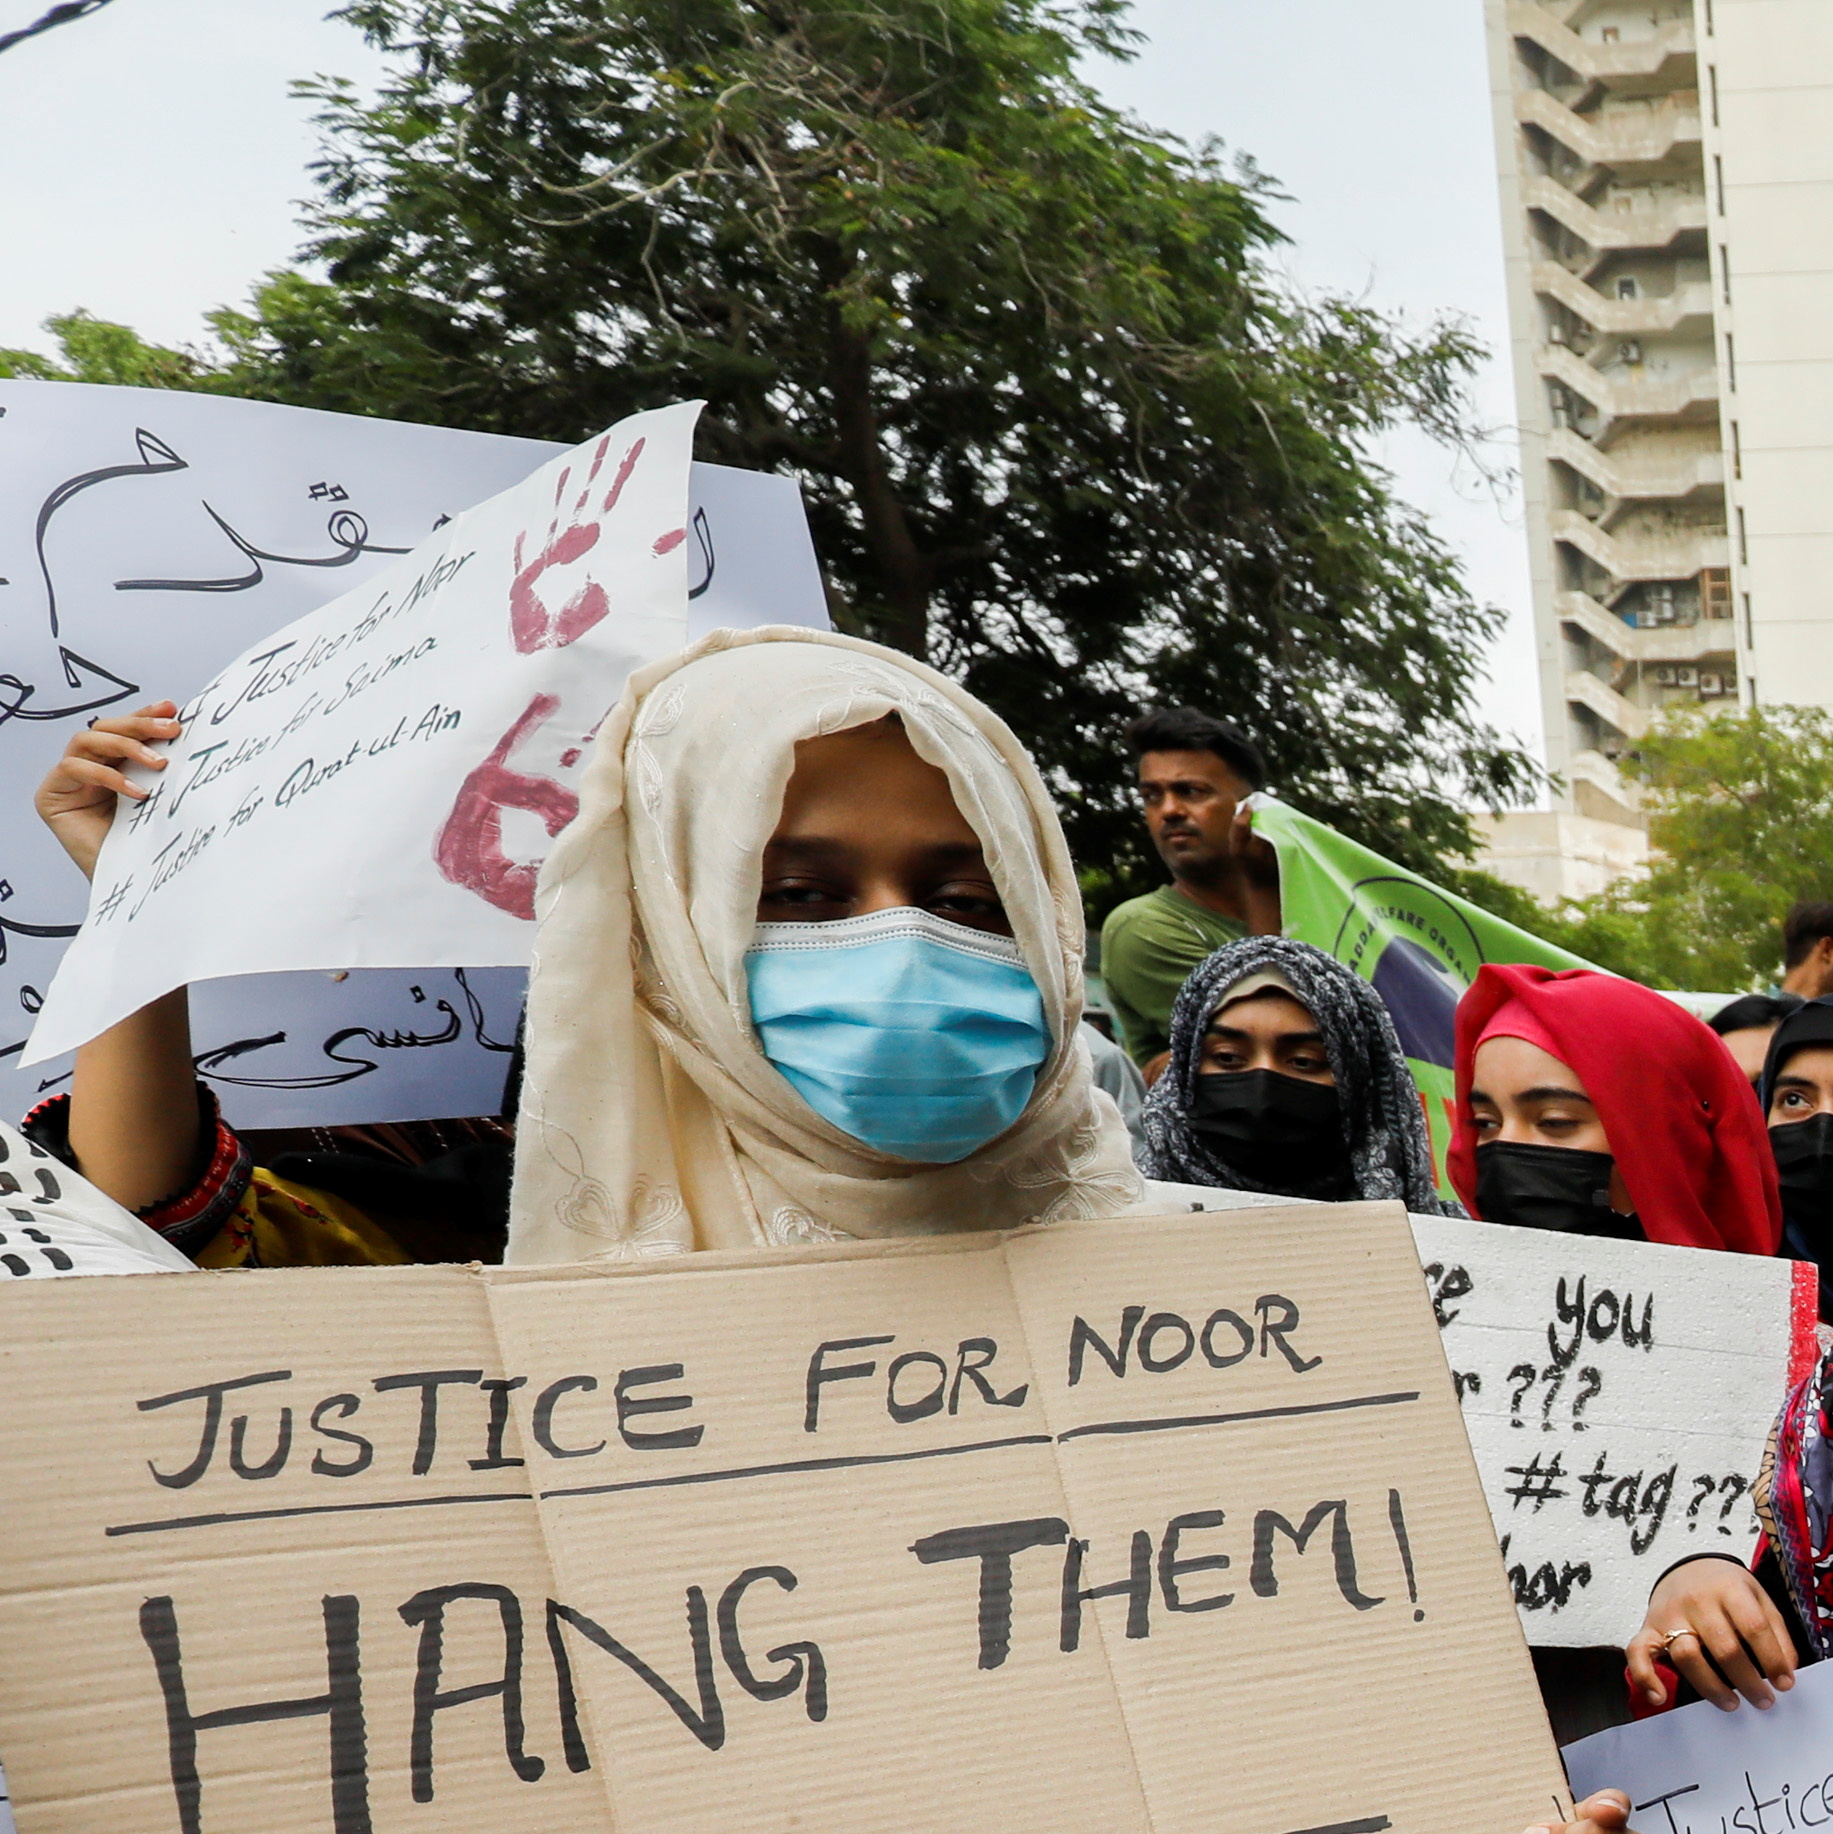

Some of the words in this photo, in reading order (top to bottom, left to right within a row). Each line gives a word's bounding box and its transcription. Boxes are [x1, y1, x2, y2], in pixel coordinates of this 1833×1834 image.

[210, 633, 347, 726] Justice
[344, 590, 392, 651] for
[168, 734, 271, 820] Justice
[128, 824, 216, 923] Justice
[223, 785, 264, 839] for
[1548, 1274, 1655, 1366] you
[136, 1362, 705, 1490] JUSTICE
[803, 1334, 1029, 1434] FOR
[1067, 1293, 1323, 1386] NOOR
[907, 1488, 1427, 1671] THEM!
